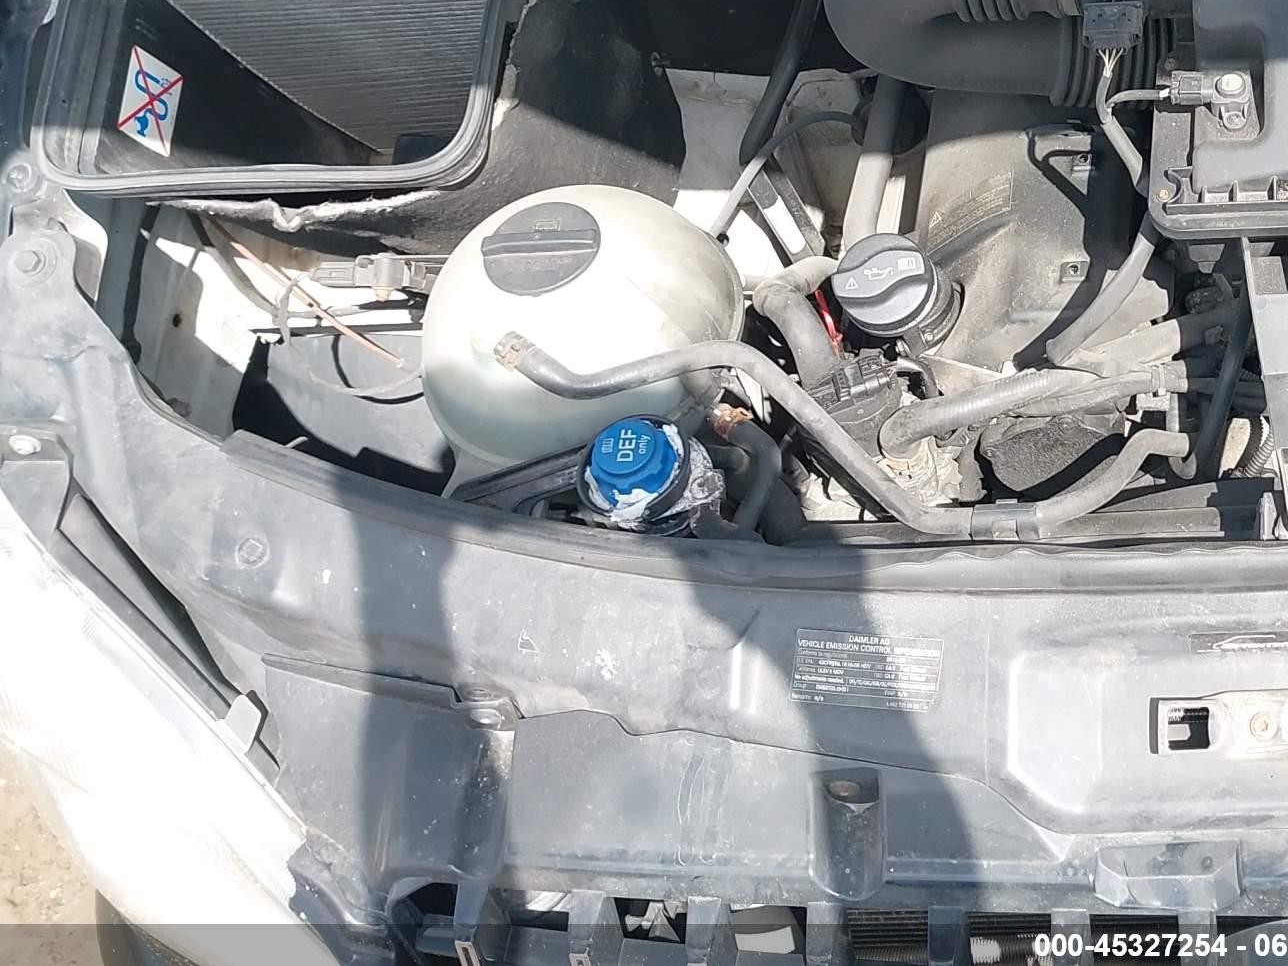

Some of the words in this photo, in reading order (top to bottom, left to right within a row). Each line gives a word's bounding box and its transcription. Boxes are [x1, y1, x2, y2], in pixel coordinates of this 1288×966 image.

[616, 429, 636, 462] DEF
[638, 435, 651, 454] only
[797, 639, 824, 648] VEHICLE
[825, 641, 859, 651] EMISSION
[860, 644, 892, 653] CONTROL
[848, 635, 879, 644] DAIMLER
